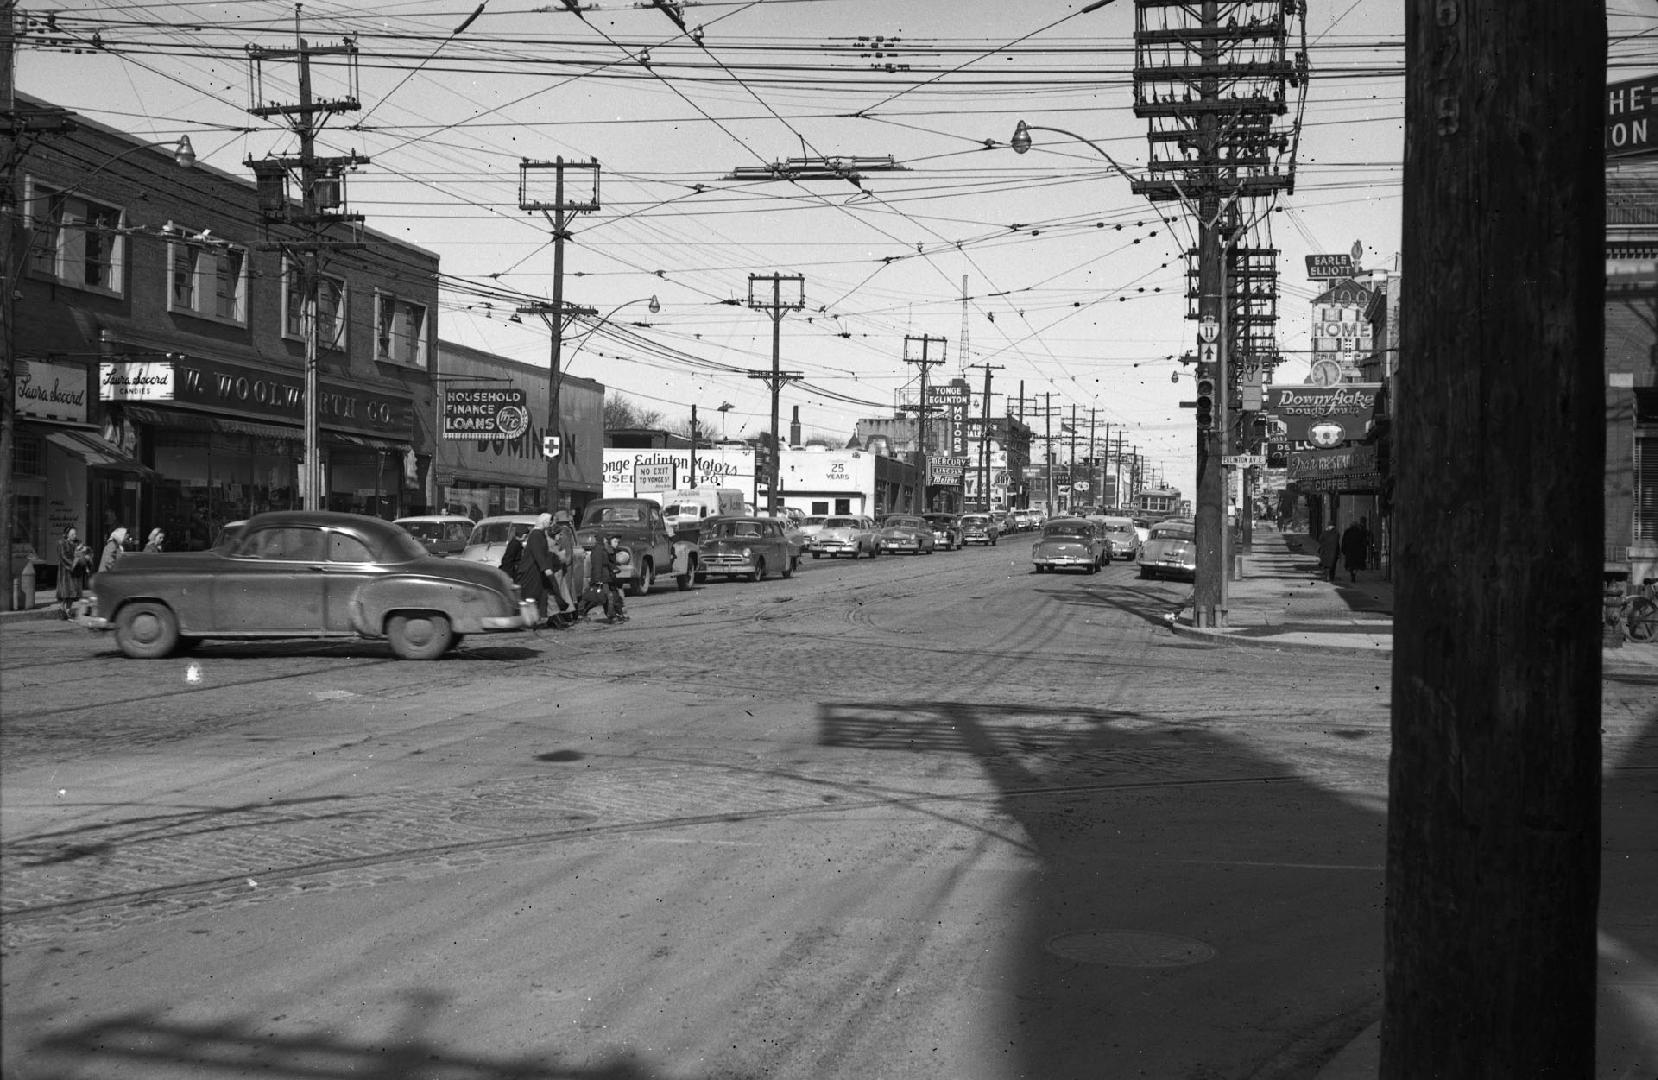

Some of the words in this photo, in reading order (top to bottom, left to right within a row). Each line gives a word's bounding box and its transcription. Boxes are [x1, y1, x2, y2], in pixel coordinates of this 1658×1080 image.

[1314, 256, 1347, 266] EARLE
[1310, 266, 1350, 276] ELLIOTT
[1205, 327, 1213, 338] 11
[1314, 322, 1371, 337] HOME
[103, 368, 131, 385] Laura
[132, 368, 169, 386] Secord
[18, 374, 48, 401] Laura
[50, 377, 84, 407] Secord
[935, 387, 962, 395] YONGE
[447, 392, 521, 402] HOUSEHOLD
[929, 396, 968, 404] EGLINTON
[446, 405, 495, 415] FINANCE
[446, 417, 495, 430] LOANS
[954, 406, 962, 452] MOTORS
[478, 424, 576, 465] OMINN
[602, 459, 630, 474] onge
[932, 457, 966, 466] MERCURY
[654, 466, 668, 475] EXIT
[831, 464, 844, 473] 25
